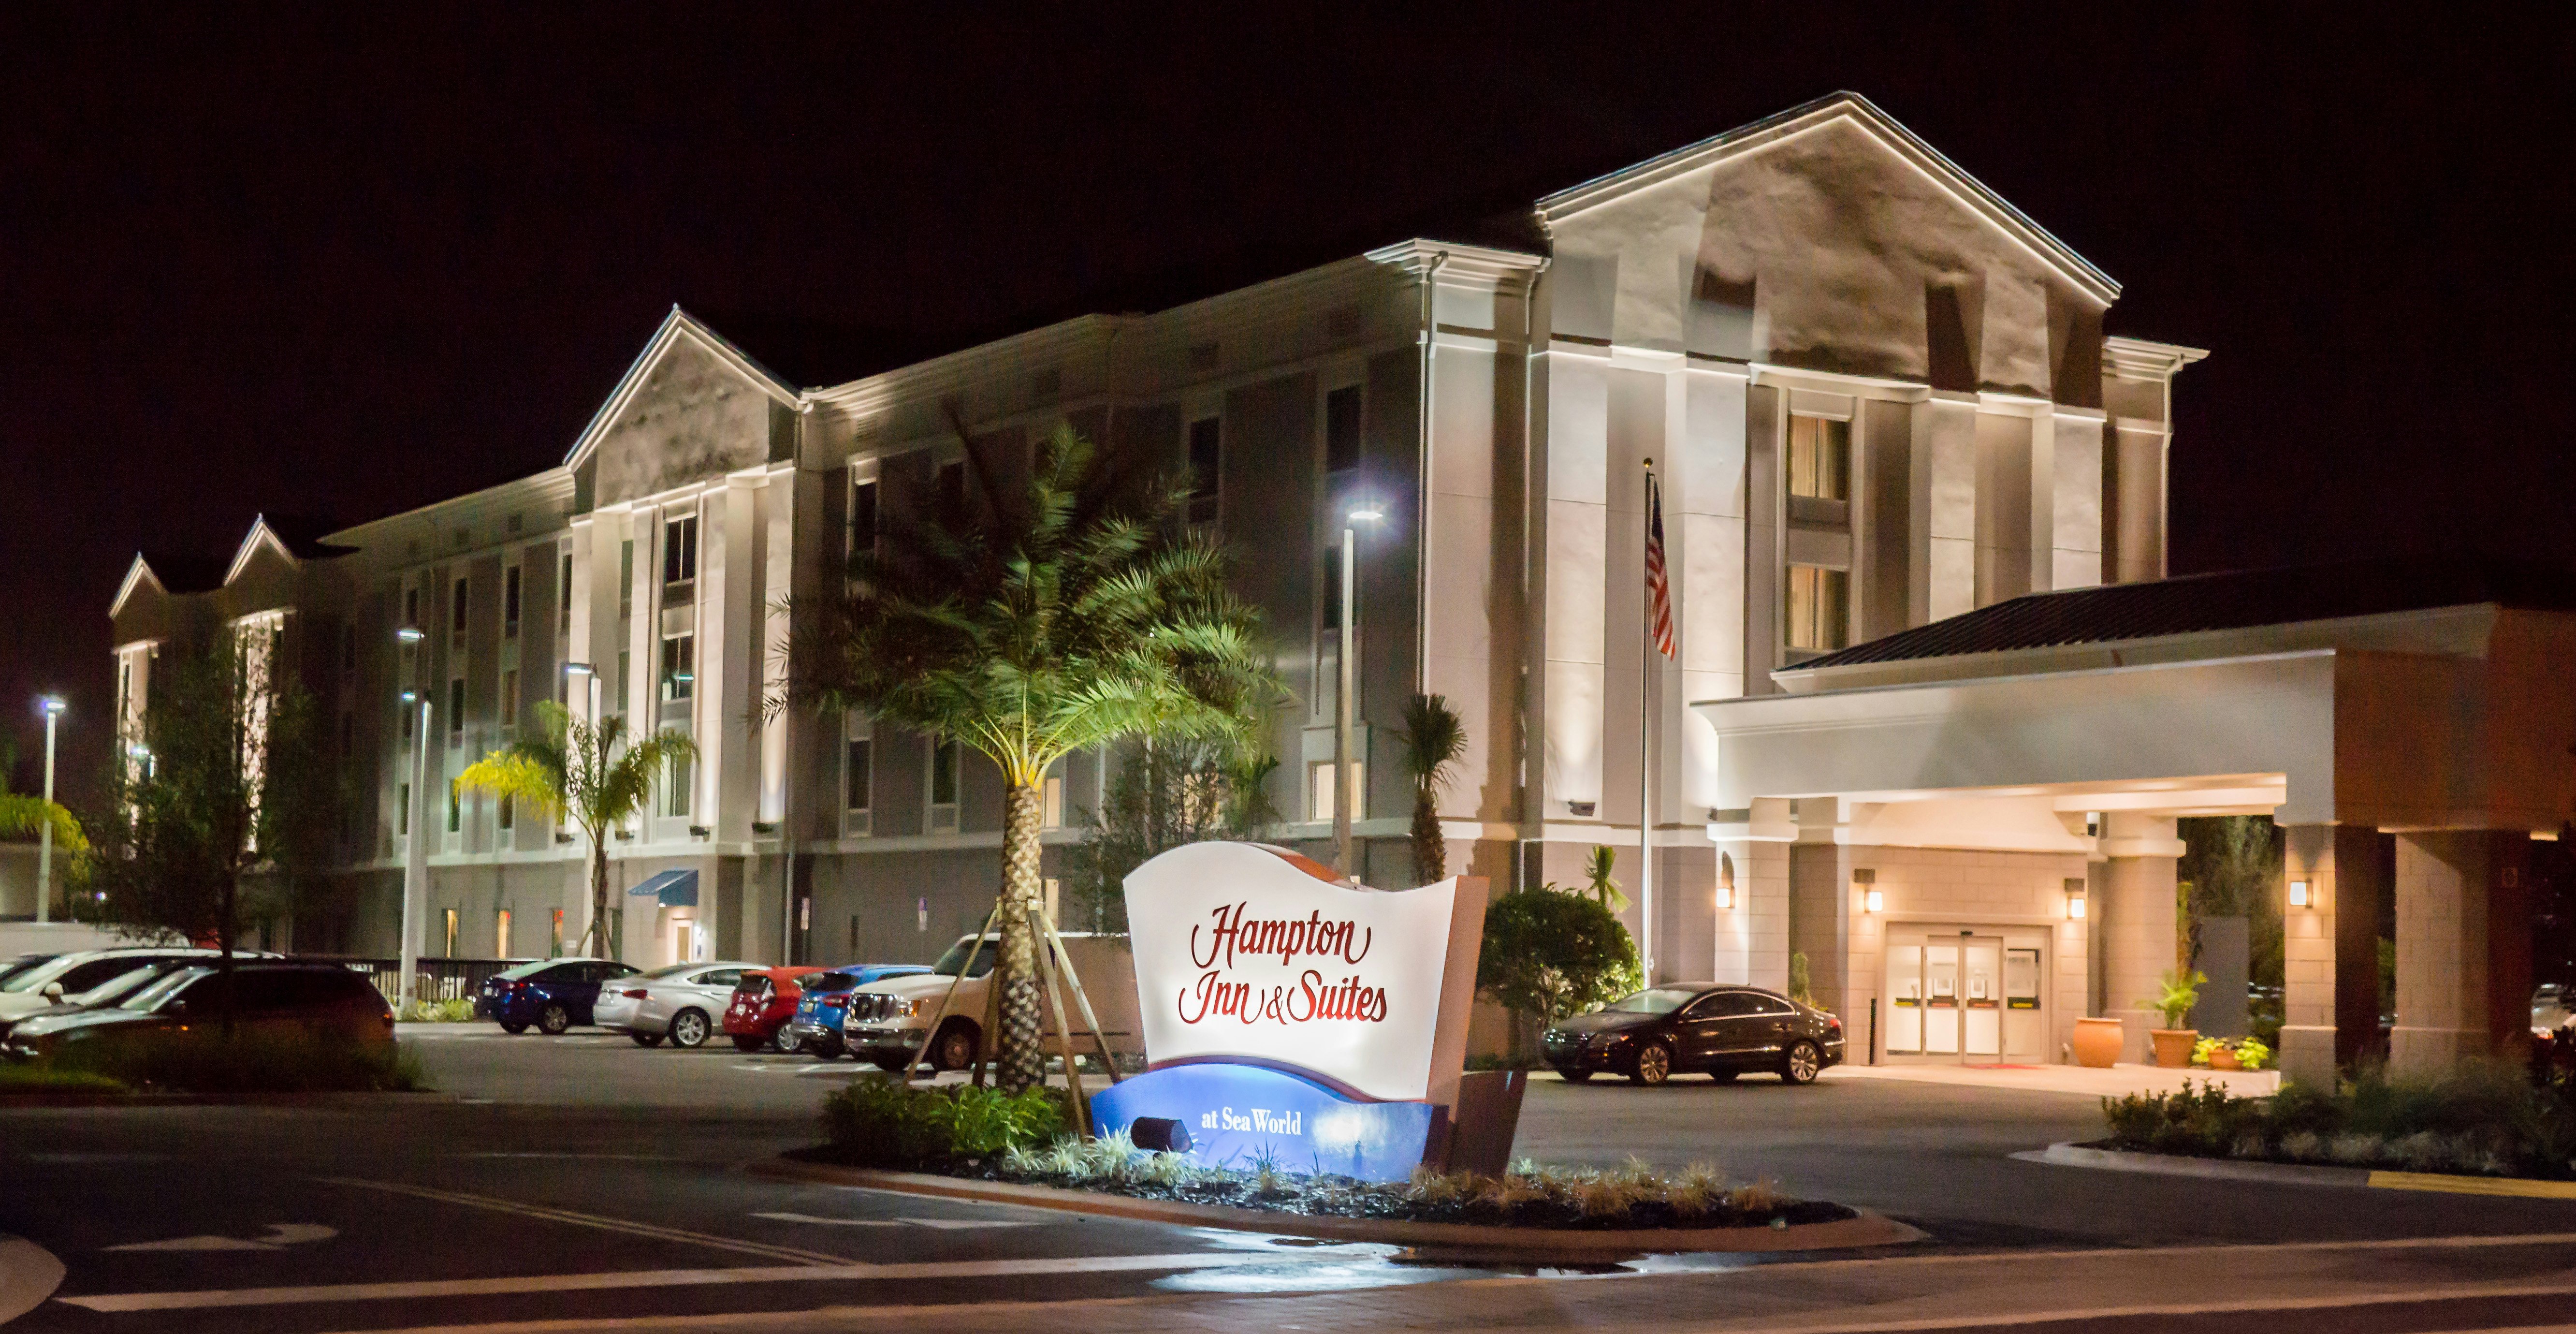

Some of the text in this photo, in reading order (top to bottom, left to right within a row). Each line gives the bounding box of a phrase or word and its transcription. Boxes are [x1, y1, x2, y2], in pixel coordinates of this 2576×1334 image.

[1191, 901, 1371, 969] Hampton
[1179, 969, 1387, 1025] Inn & Suites
[1201, 1106, 1302, 1135] at Sea World
